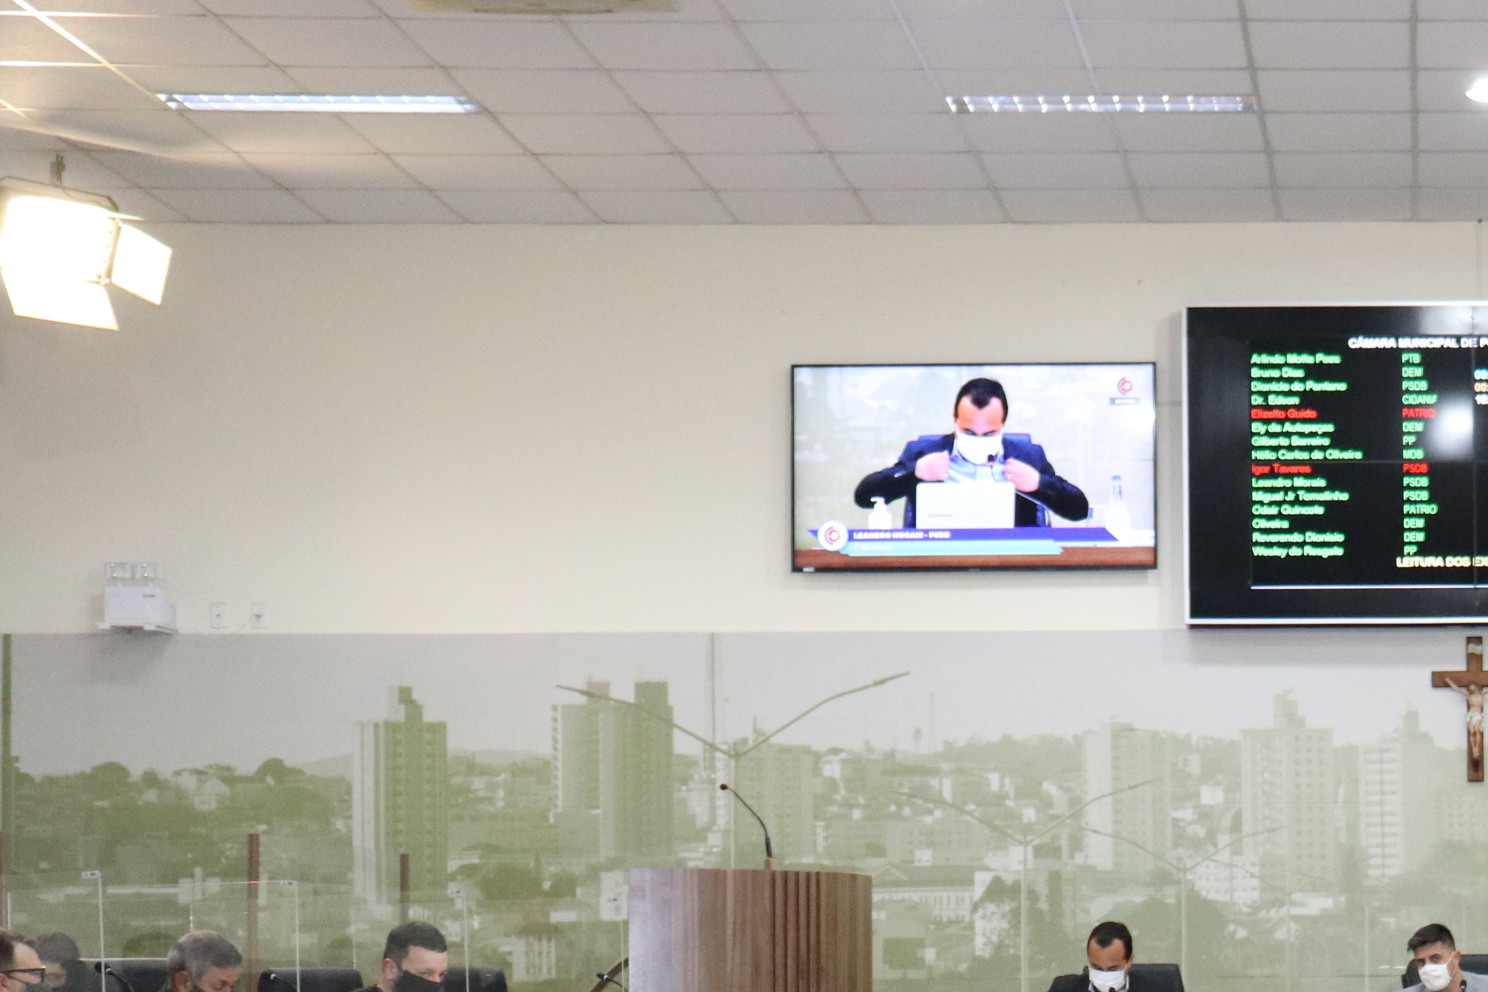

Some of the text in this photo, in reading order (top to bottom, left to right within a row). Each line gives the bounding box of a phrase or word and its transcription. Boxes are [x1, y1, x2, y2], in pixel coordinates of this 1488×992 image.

[1348, 336, 1396, 348] CÂMARA
[1398, 338, 1459, 348] MUNICIPAL
[1461, 338, 1477, 348] DE
[1251, 354, 1341, 364] Arlindo Motta Paes
[1402, 353, 1421, 364] PTB
[1251, 367, 1305, 378] Bruno Dias
[1402, 367, 1423, 377] DEM
[1291, 381, 1304, 391] do
[1402, 381, 1428, 391] PSDB
[1268, 395, 1300, 405] Edson
[1251, 423, 1266, 434] Ely
[1268, 423, 1281, 433] da
[1402, 422, 1424, 432] DEM
[1251, 437, 1330, 446] Gilberto Barreiro
[1402, 436, 1416, 446] PP
[1278, 450, 1309, 460] Carlos
[1311, 450, 1324, 460] de
[1326, 450, 1362, 460] Oliveira
[1402, 449, 1424, 459] MDB
[1252, 463, 1312, 475] Igor Tavares
[1402, 463, 1429, 474] PSDB
[1252, 478, 1326, 487] Leandro Morais
[1403, 477, 1429, 487] PSDB
[1252, 491, 1284, 503] Miguel
[1403, 490, 1429, 501] PSDB
[1252, 505, 1279, 515] Odair
[1403, 504, 1438, 514] PATRIO
[1252, 519, 1289, 529] Oliveira
[1403, 518, 1425, 528] DEM
[1252, 533, 1304, 542] Reverendo
[1404, 532, 1425, 542] DEM
[1252, 547, 1287, 558] Wesley
[1289, 547, 1302, 556] do
[1404, 546, 1418, 556] PP
[1396, 557, 1444, 567] LEITURA
[1446, 557, 1471, 567] DOS
